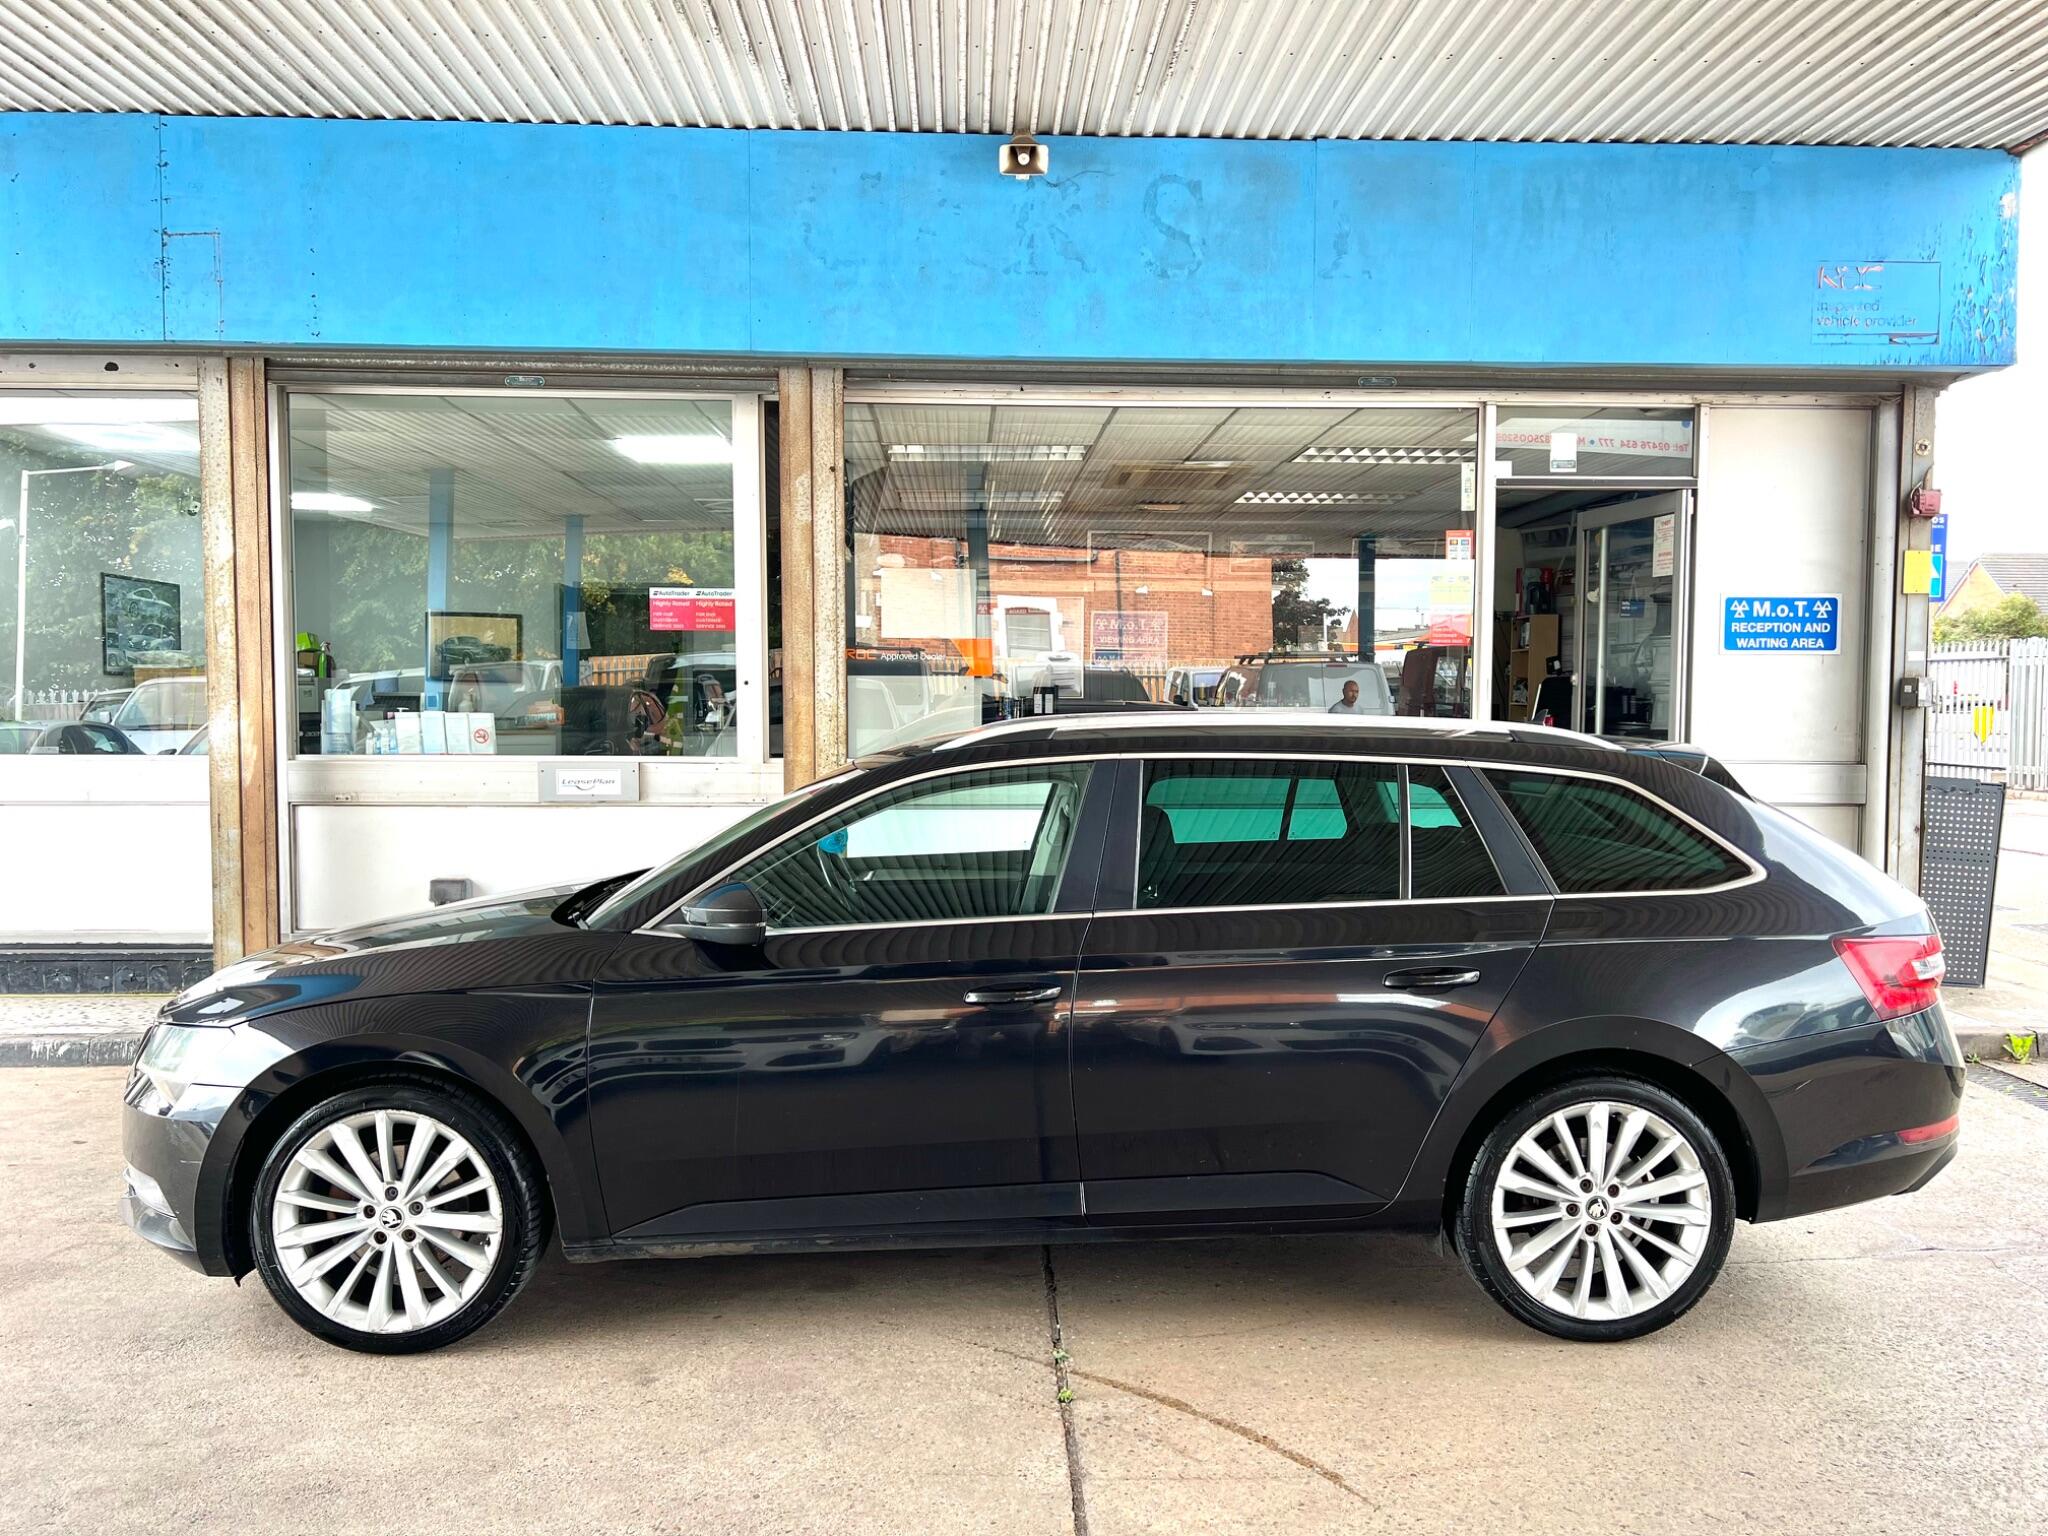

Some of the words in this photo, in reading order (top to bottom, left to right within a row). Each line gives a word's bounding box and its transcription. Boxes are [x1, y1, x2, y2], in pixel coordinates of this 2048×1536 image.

[1752, 600, 1810, 618] M.o.T.
[1731, 622, 1801, 633] RECEPTION
[1803, 622, 1831, 633] AND
[1736, 637, 1789, 649] WAITING
[1790, 638, 1825, 648] AREA
[880, 652, 918, 661] Approved
